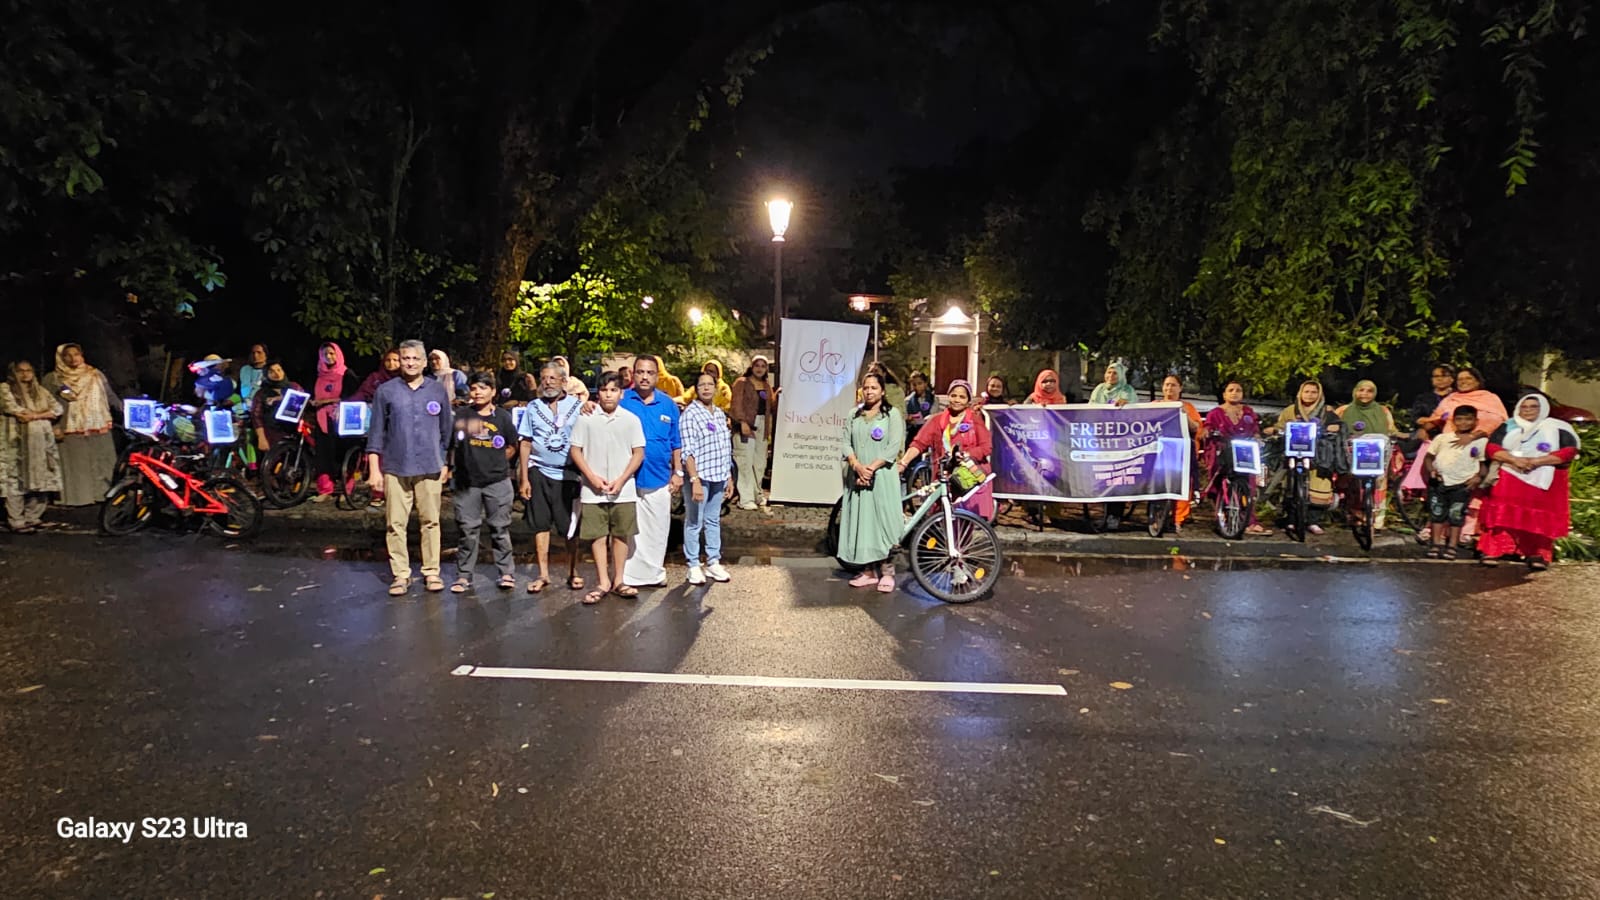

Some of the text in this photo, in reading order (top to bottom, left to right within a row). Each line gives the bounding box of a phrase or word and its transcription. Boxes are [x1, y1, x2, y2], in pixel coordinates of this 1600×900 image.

[798, 372, 845, 385] CYCLING
[784, 411, 848, 427] She Cyclin
[1009, 422, 1040, 431] WOMEN
[1070, 421, 1162, 436] FREEDOM
[794, 433, 818, 441] Bicycle
[793, 442, 829, 452] Campaign
[1070, 437, 1120, 449] NIGHT
[783, 452, 808, 460] Women
[795, 462, 833, 471] BYCS INDIA
